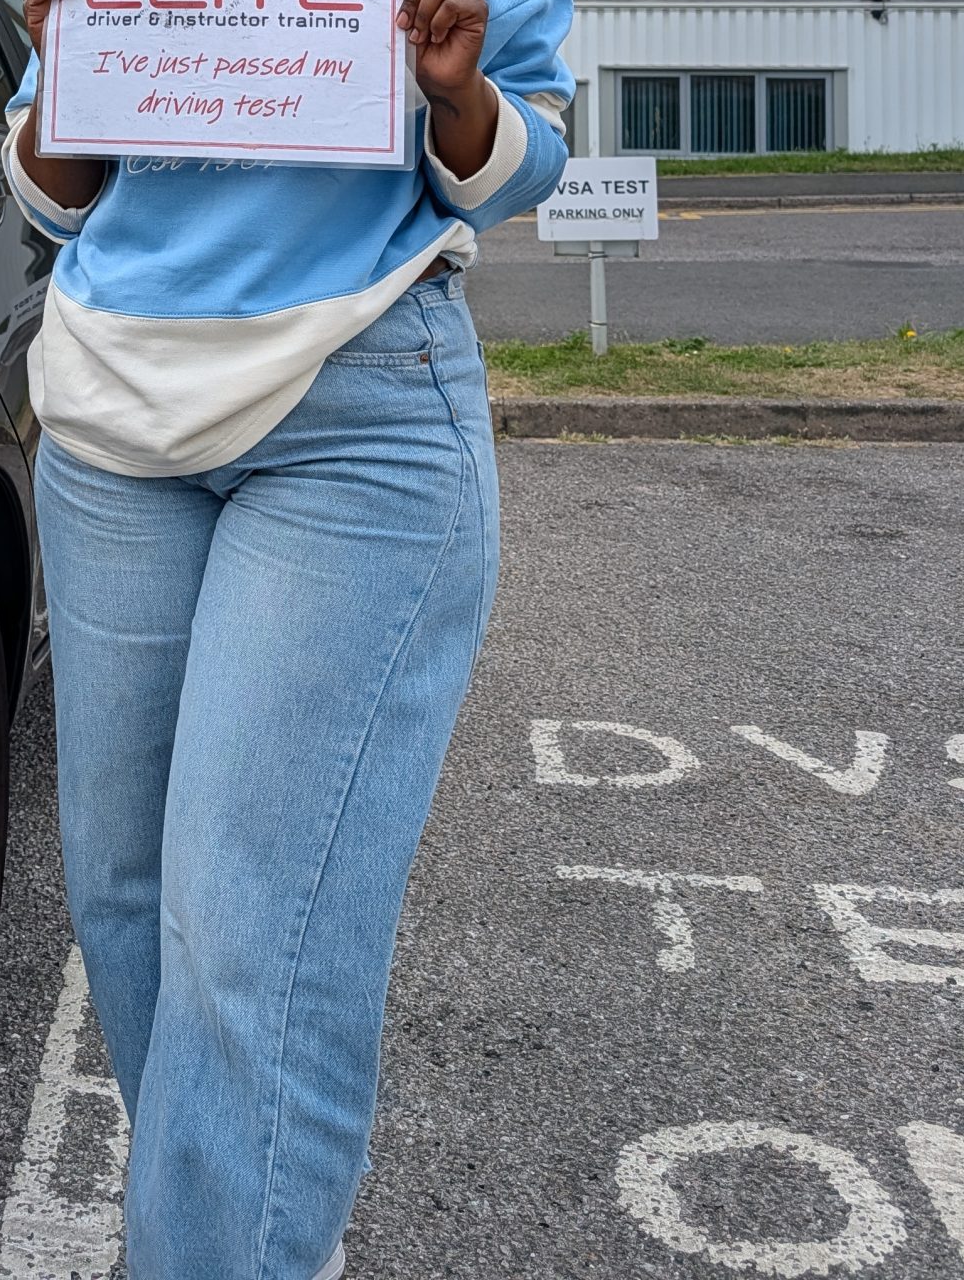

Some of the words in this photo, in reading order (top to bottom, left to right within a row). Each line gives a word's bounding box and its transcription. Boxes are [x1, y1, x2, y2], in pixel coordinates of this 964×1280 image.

[87, 10, 141, 27] driver
[148, 12, 160, 26] &
[168, 10, 269, 28] instructor
[278, 12, 360, 33] training
[93, 50, 149, 74] I've
[149, 48, 208, 79] just
[212, 50, 308, 79] passed
[313, 57, 353, 83] my
[137, 88, 224, 124] driving
[233, 94, 302, 118] test!
[556, 181, 594, 195] VSA
[601, 179, 649, 194] TEST
[548, 207, 607, 219] PARKING
[612, 207, 645, 218] ONLY
